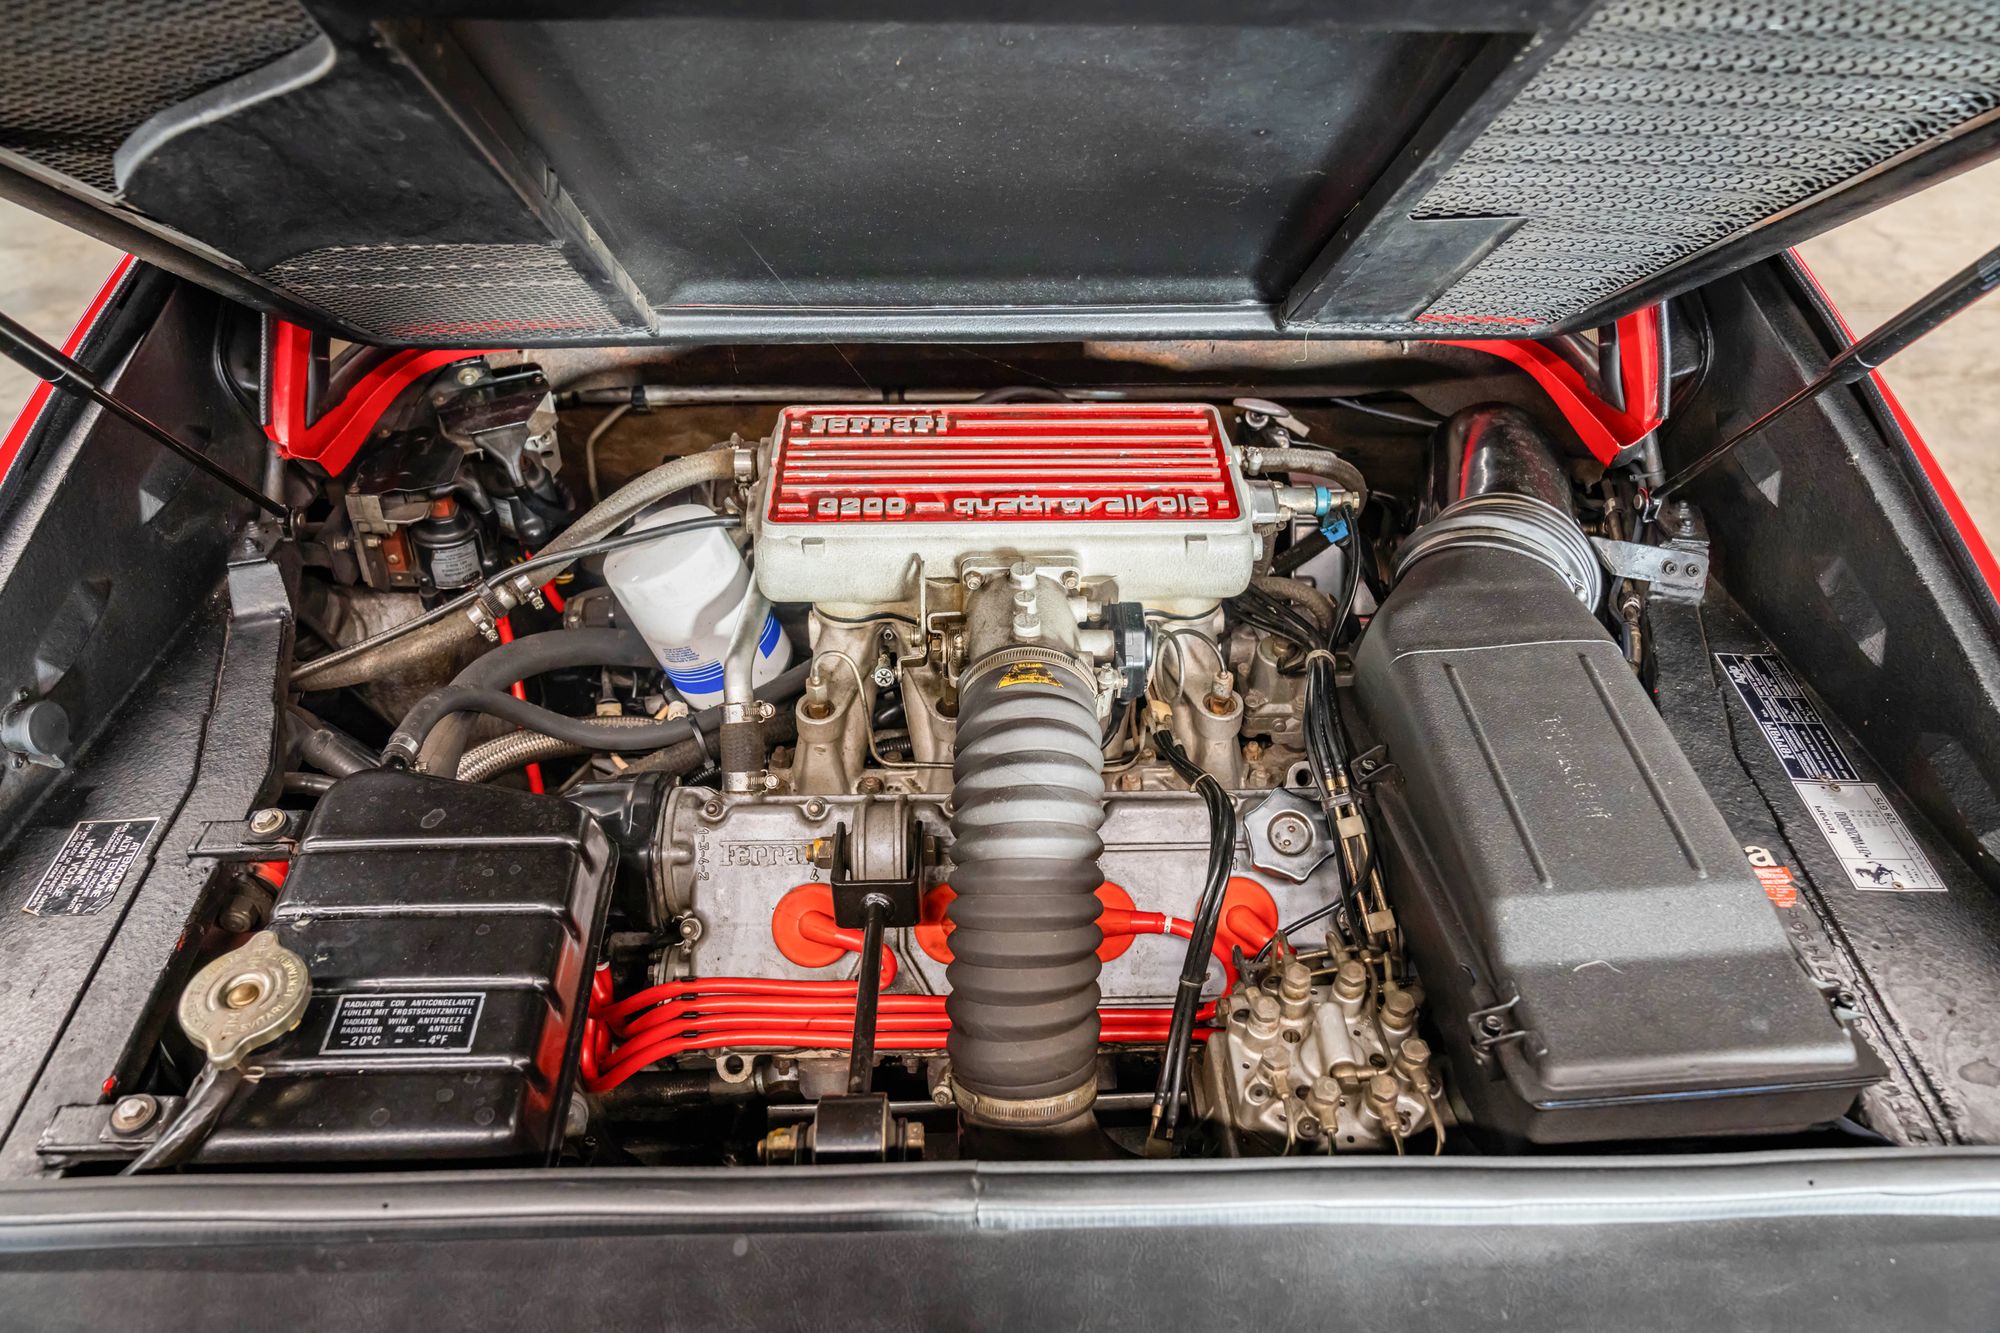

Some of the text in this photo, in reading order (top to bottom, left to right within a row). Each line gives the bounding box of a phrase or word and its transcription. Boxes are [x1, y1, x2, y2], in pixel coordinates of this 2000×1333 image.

[817, 493, 1209, 520] 3200 quadrovalvole
[1728, 665, 1748, 685] Agip
[1760, 721, 1795, 759] Ferrari
[1872, 797, 1889, 810] GTS
[1883, 812, 1898, 824] 328
[53, 838, 96, 897] HIGH VOLTAGE
[72, 847, 102, 885] WARNING
[91, 835, 134, 898] ALTA TENSIONE
[105, 842, 141, 893] ATTENZIONE
[344, 1000, 385, 1008] RADIATORE
[410, 999, 476, 1007] ANTICONGELANTE
[392, 1007, 473, 1016] FROSTSCHUTZMITTEL
[340, 1025, 463, 1035] RADIATEUR AVEC ANTIGEL
[343, 1018, 379, 1026] RADIATOR
[417, 1016, 466, 1025] ANTIFREEZE
